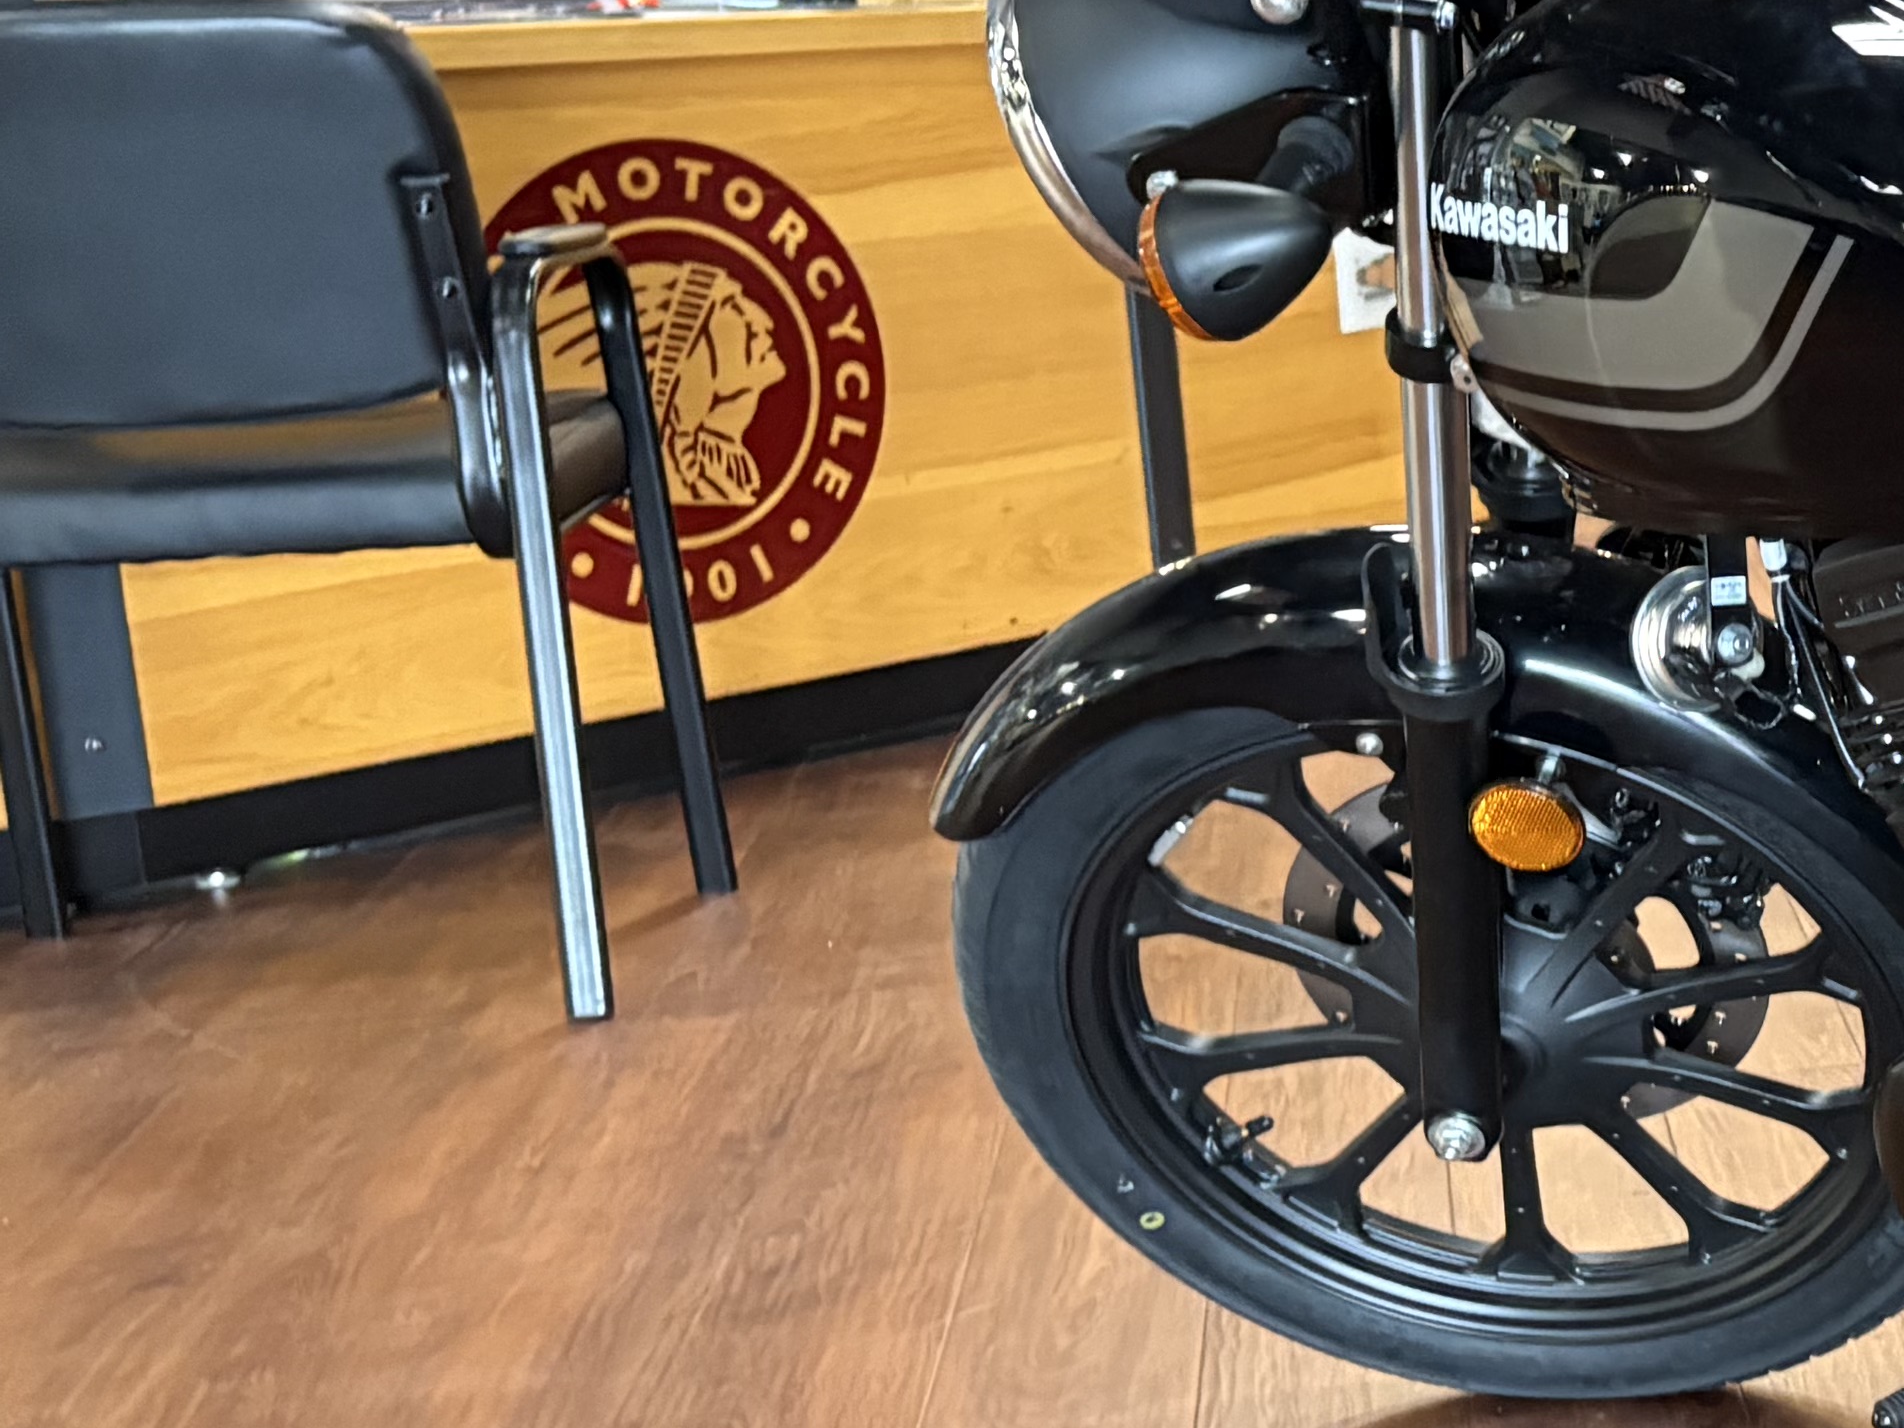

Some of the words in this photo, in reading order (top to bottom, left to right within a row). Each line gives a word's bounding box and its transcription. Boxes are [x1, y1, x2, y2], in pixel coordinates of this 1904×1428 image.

[1430, 182, 1569, 255] Kawasaki
[551, 156, 871, 502] MOTORCYCLE
[625, 544, 776, 608] 101
